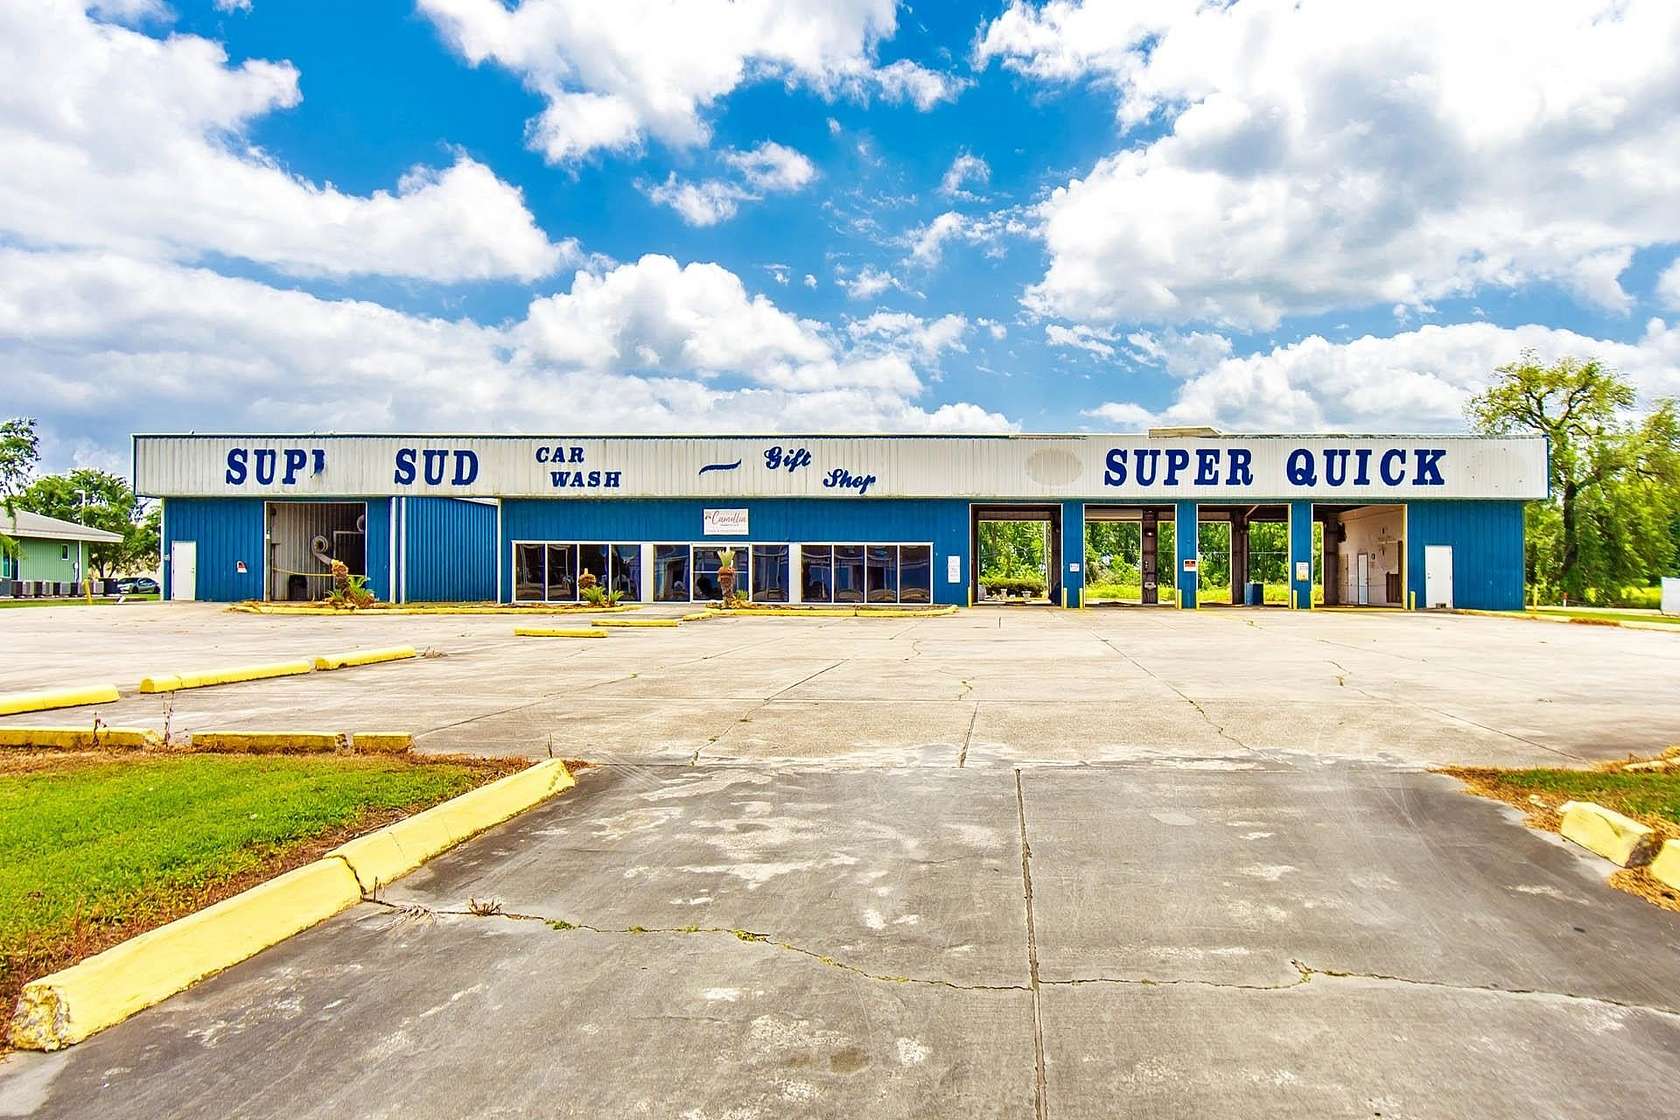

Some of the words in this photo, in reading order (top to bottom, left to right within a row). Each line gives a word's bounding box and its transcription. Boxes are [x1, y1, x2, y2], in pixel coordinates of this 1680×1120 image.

[395, 449, 479, 485] SUD
[536, 447, 585, 463] CAR
[764, 446, 812, 472] Gift
[1105, 449, 1253, 486] SUPER
[1287, 449, 1447, 487] QUICK
[551, 471, 622, 487] WASH
[823, 468, 877, 494] Shop
